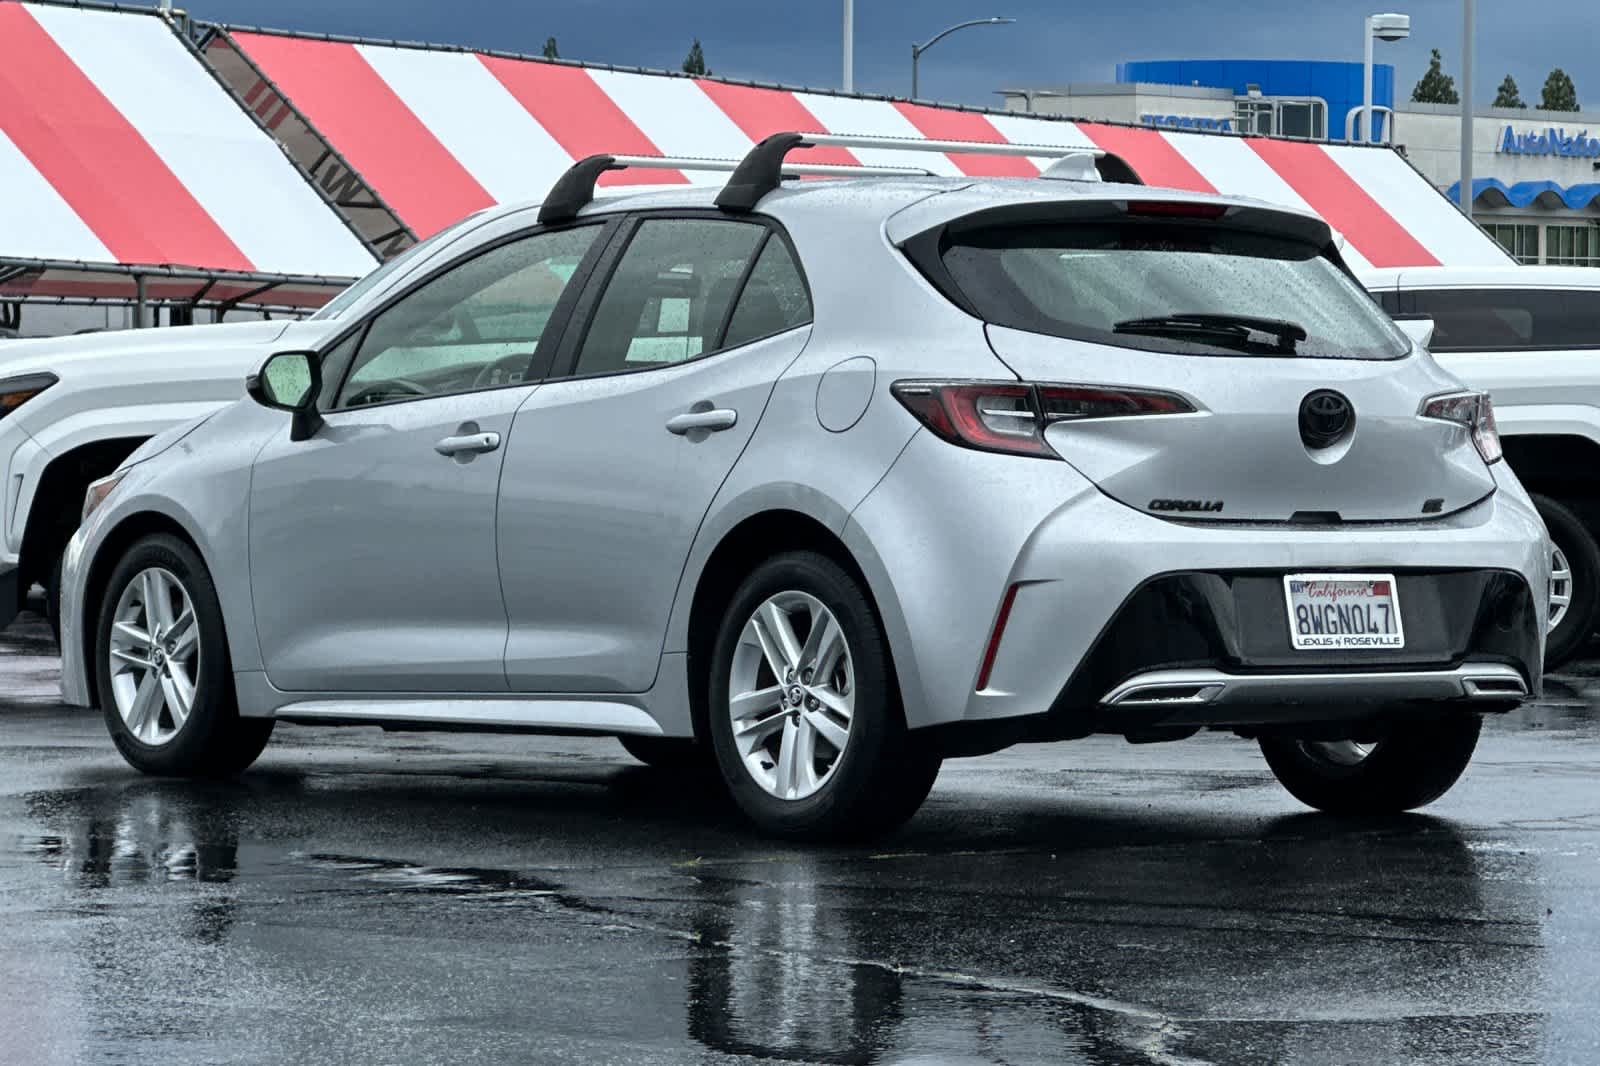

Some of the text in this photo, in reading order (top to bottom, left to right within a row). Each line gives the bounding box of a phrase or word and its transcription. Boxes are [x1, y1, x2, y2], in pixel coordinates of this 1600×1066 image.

[1147, 498, 1225, 513] COROLLA
[1309, 580, 1368, 602] California
[1296, 603, 1391, 635] 8WGN047
[1297, 637, 1333, 646] LEXUS
[1343, 636, 1401, 646] ROSEVILLE
